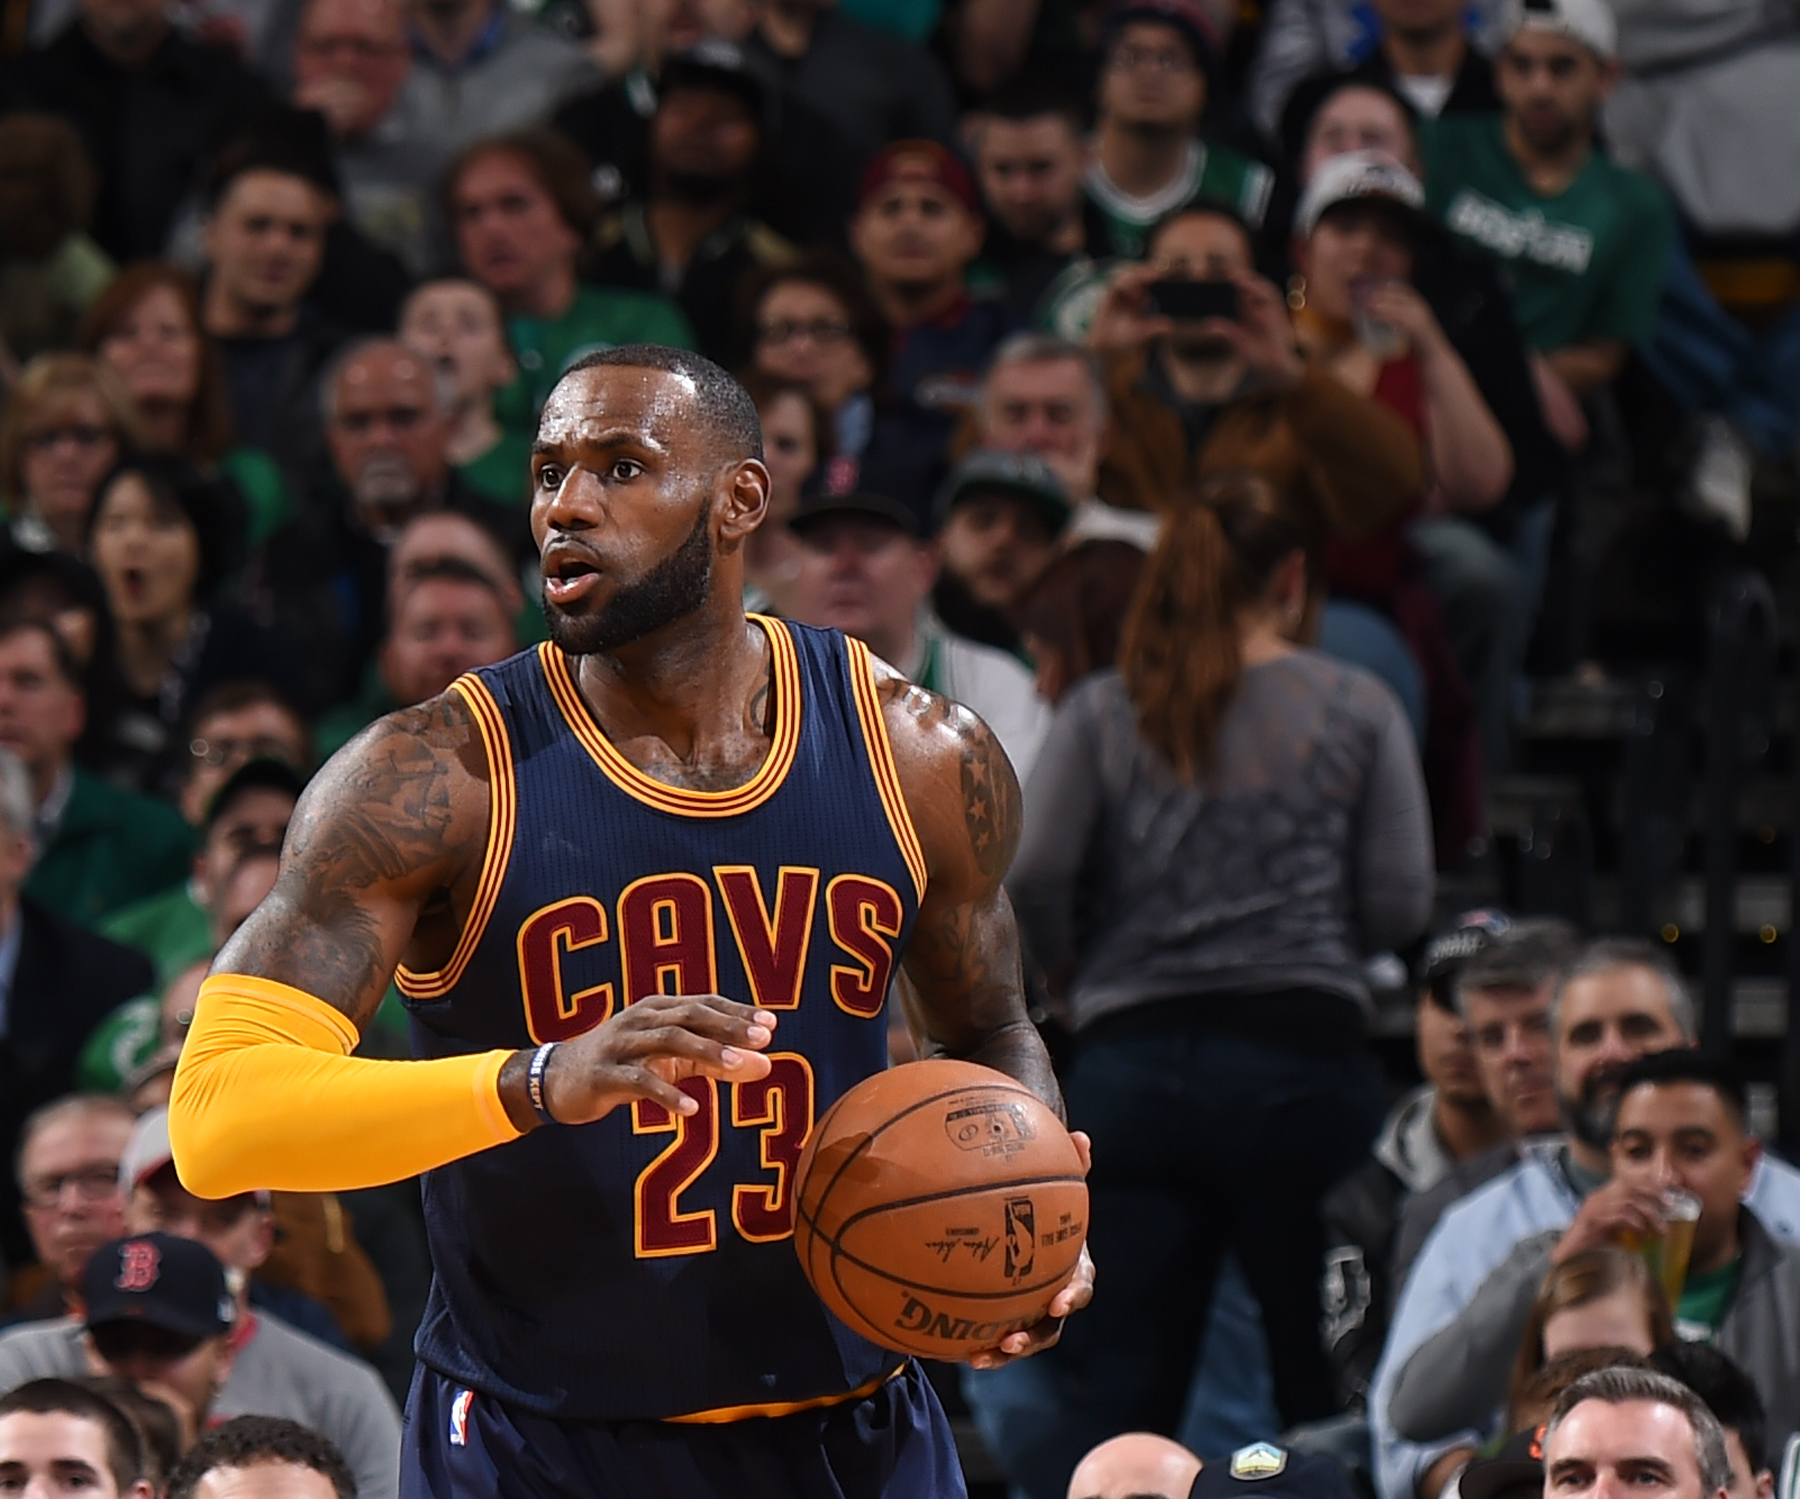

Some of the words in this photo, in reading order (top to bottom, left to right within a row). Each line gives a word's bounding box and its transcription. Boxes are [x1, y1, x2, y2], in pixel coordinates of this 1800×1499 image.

[516, 865, 903, 1048] CAVS
[632, 1052, 815, 1258] 23
[114, 1241, 161, 1292] B
